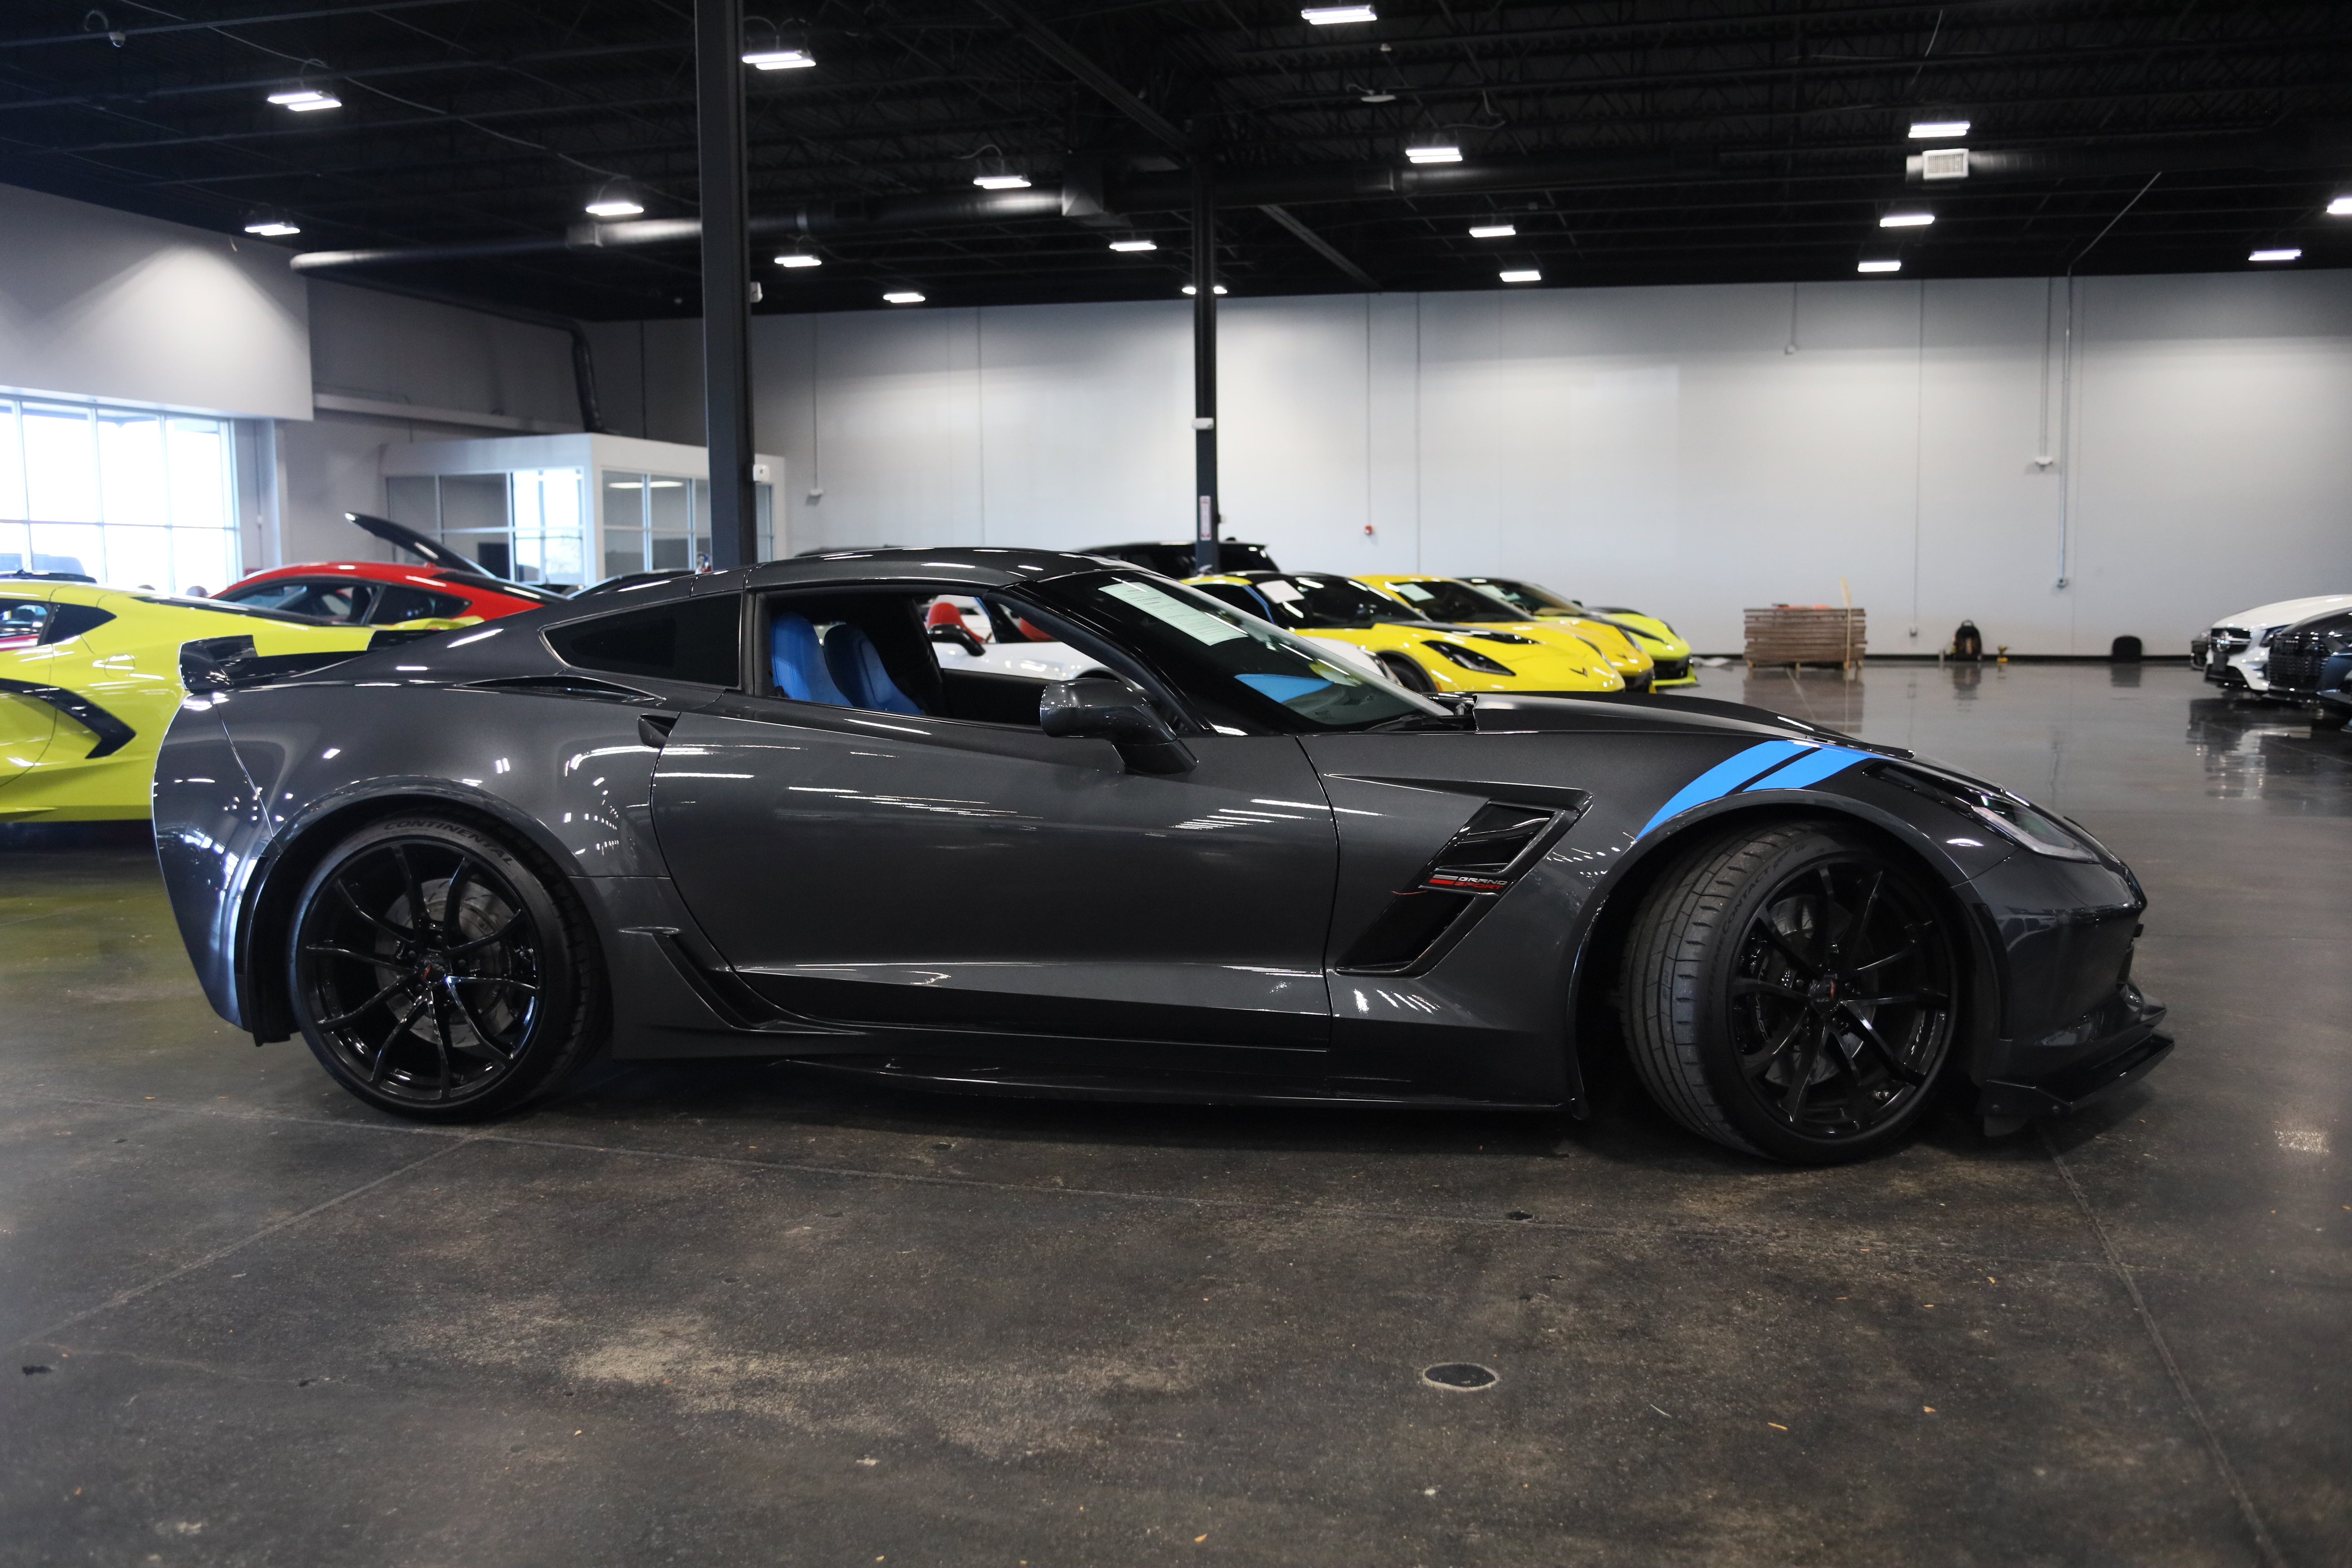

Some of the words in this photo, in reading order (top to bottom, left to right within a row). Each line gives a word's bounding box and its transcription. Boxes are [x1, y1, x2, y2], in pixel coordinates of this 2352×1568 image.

[384, 820, 513, 866] CONTINENTAL
[1454, 881, 1505, 889] SPORT
[1458, 877, 1508, 885] GRAND
